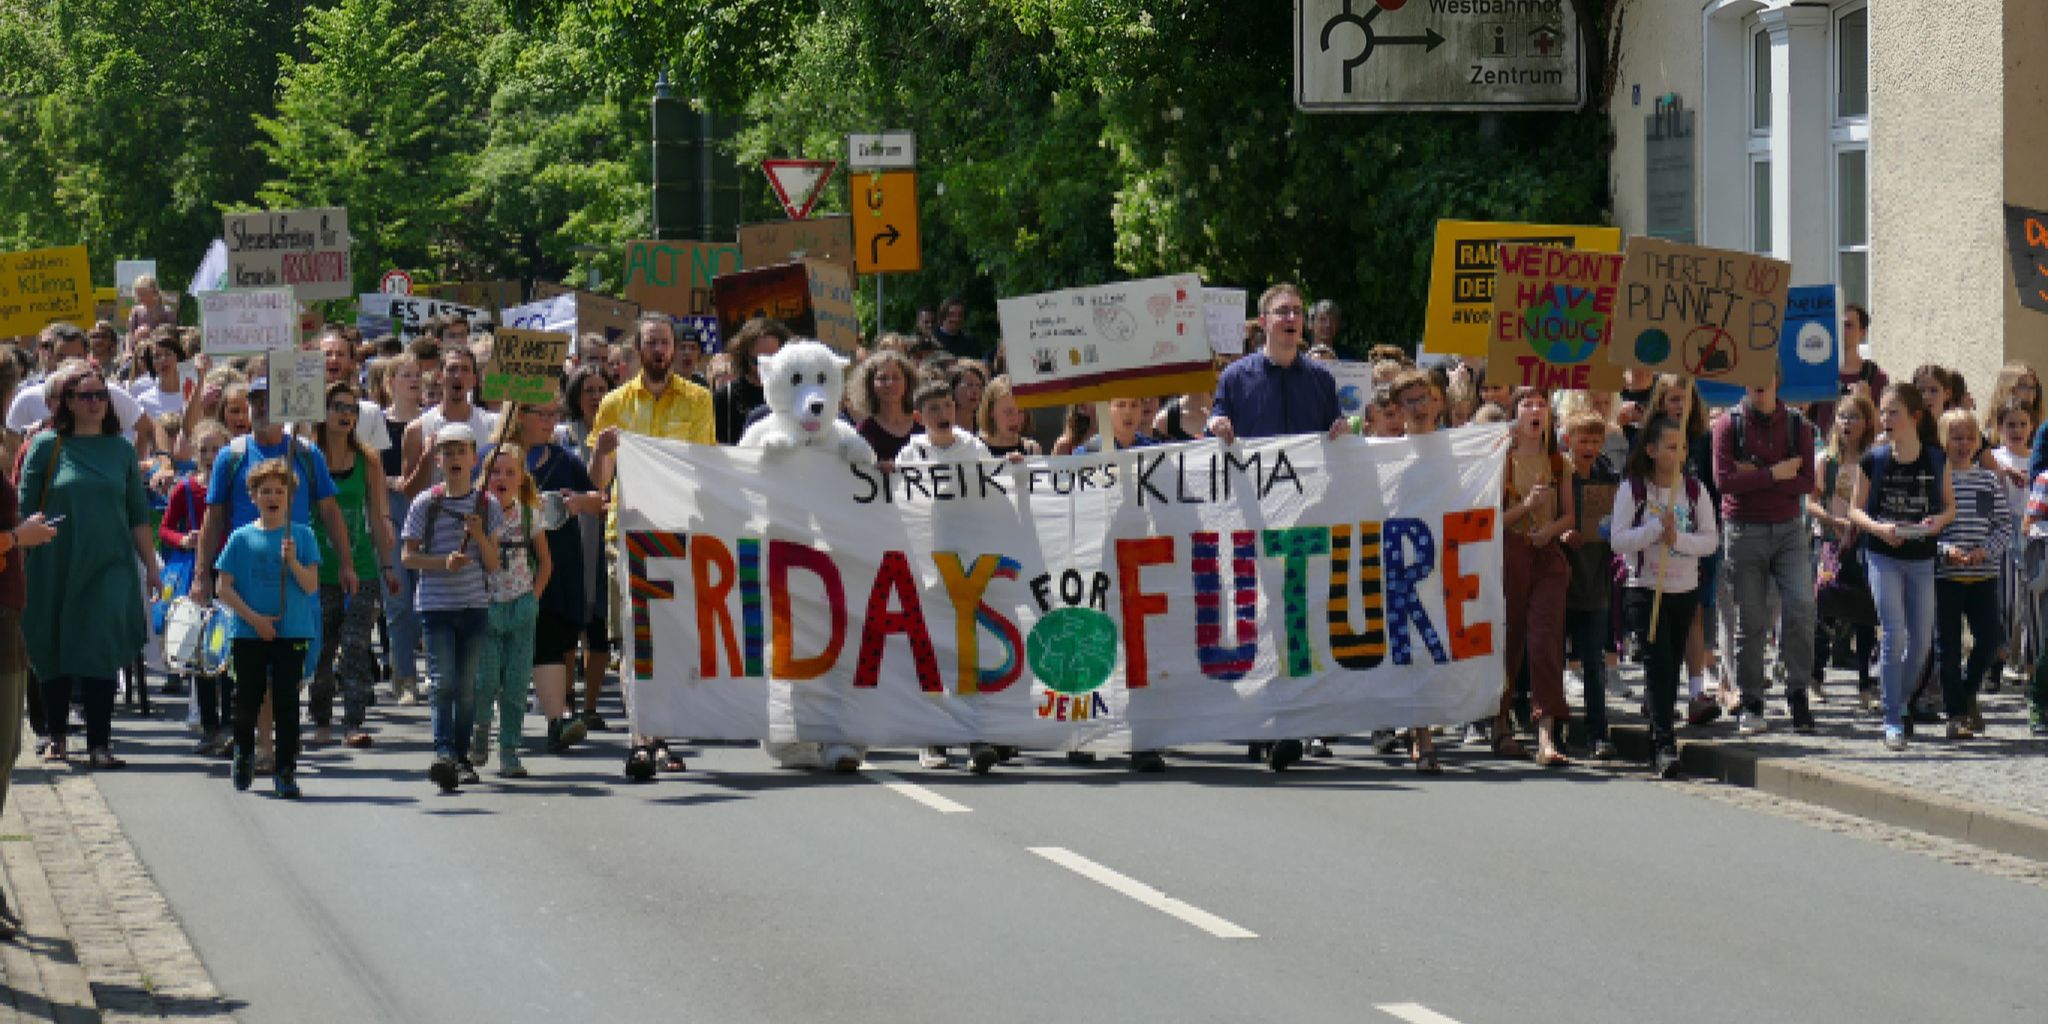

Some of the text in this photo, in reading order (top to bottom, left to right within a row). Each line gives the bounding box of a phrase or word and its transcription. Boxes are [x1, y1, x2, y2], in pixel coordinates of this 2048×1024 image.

[1429, 0, 1562, 14] Westbahnhof
[1470, 64, 1563, 85] Zentrum
[624, 243, 686, 288] ACT
[1499, 244, 1626, 283] WE DON'T
[1640, 251, 1780, 296] THERE IS NO
[17, 273, 76, 294] Klima
[1517, 280, 1617, 315] HAVE
[390, 302, 420, 320] ES
[1628, 282, 1744, 328] PLANET
[1748, 299, 1781, 351] B
[1515, 355, 1591, 390] TIME
[1136, 449, 1304, 507] KLIMA
[625, 507, 1496, 696] FRIDAYS FOR FUTURE
[1037, 690, 1110, 722] JENA
